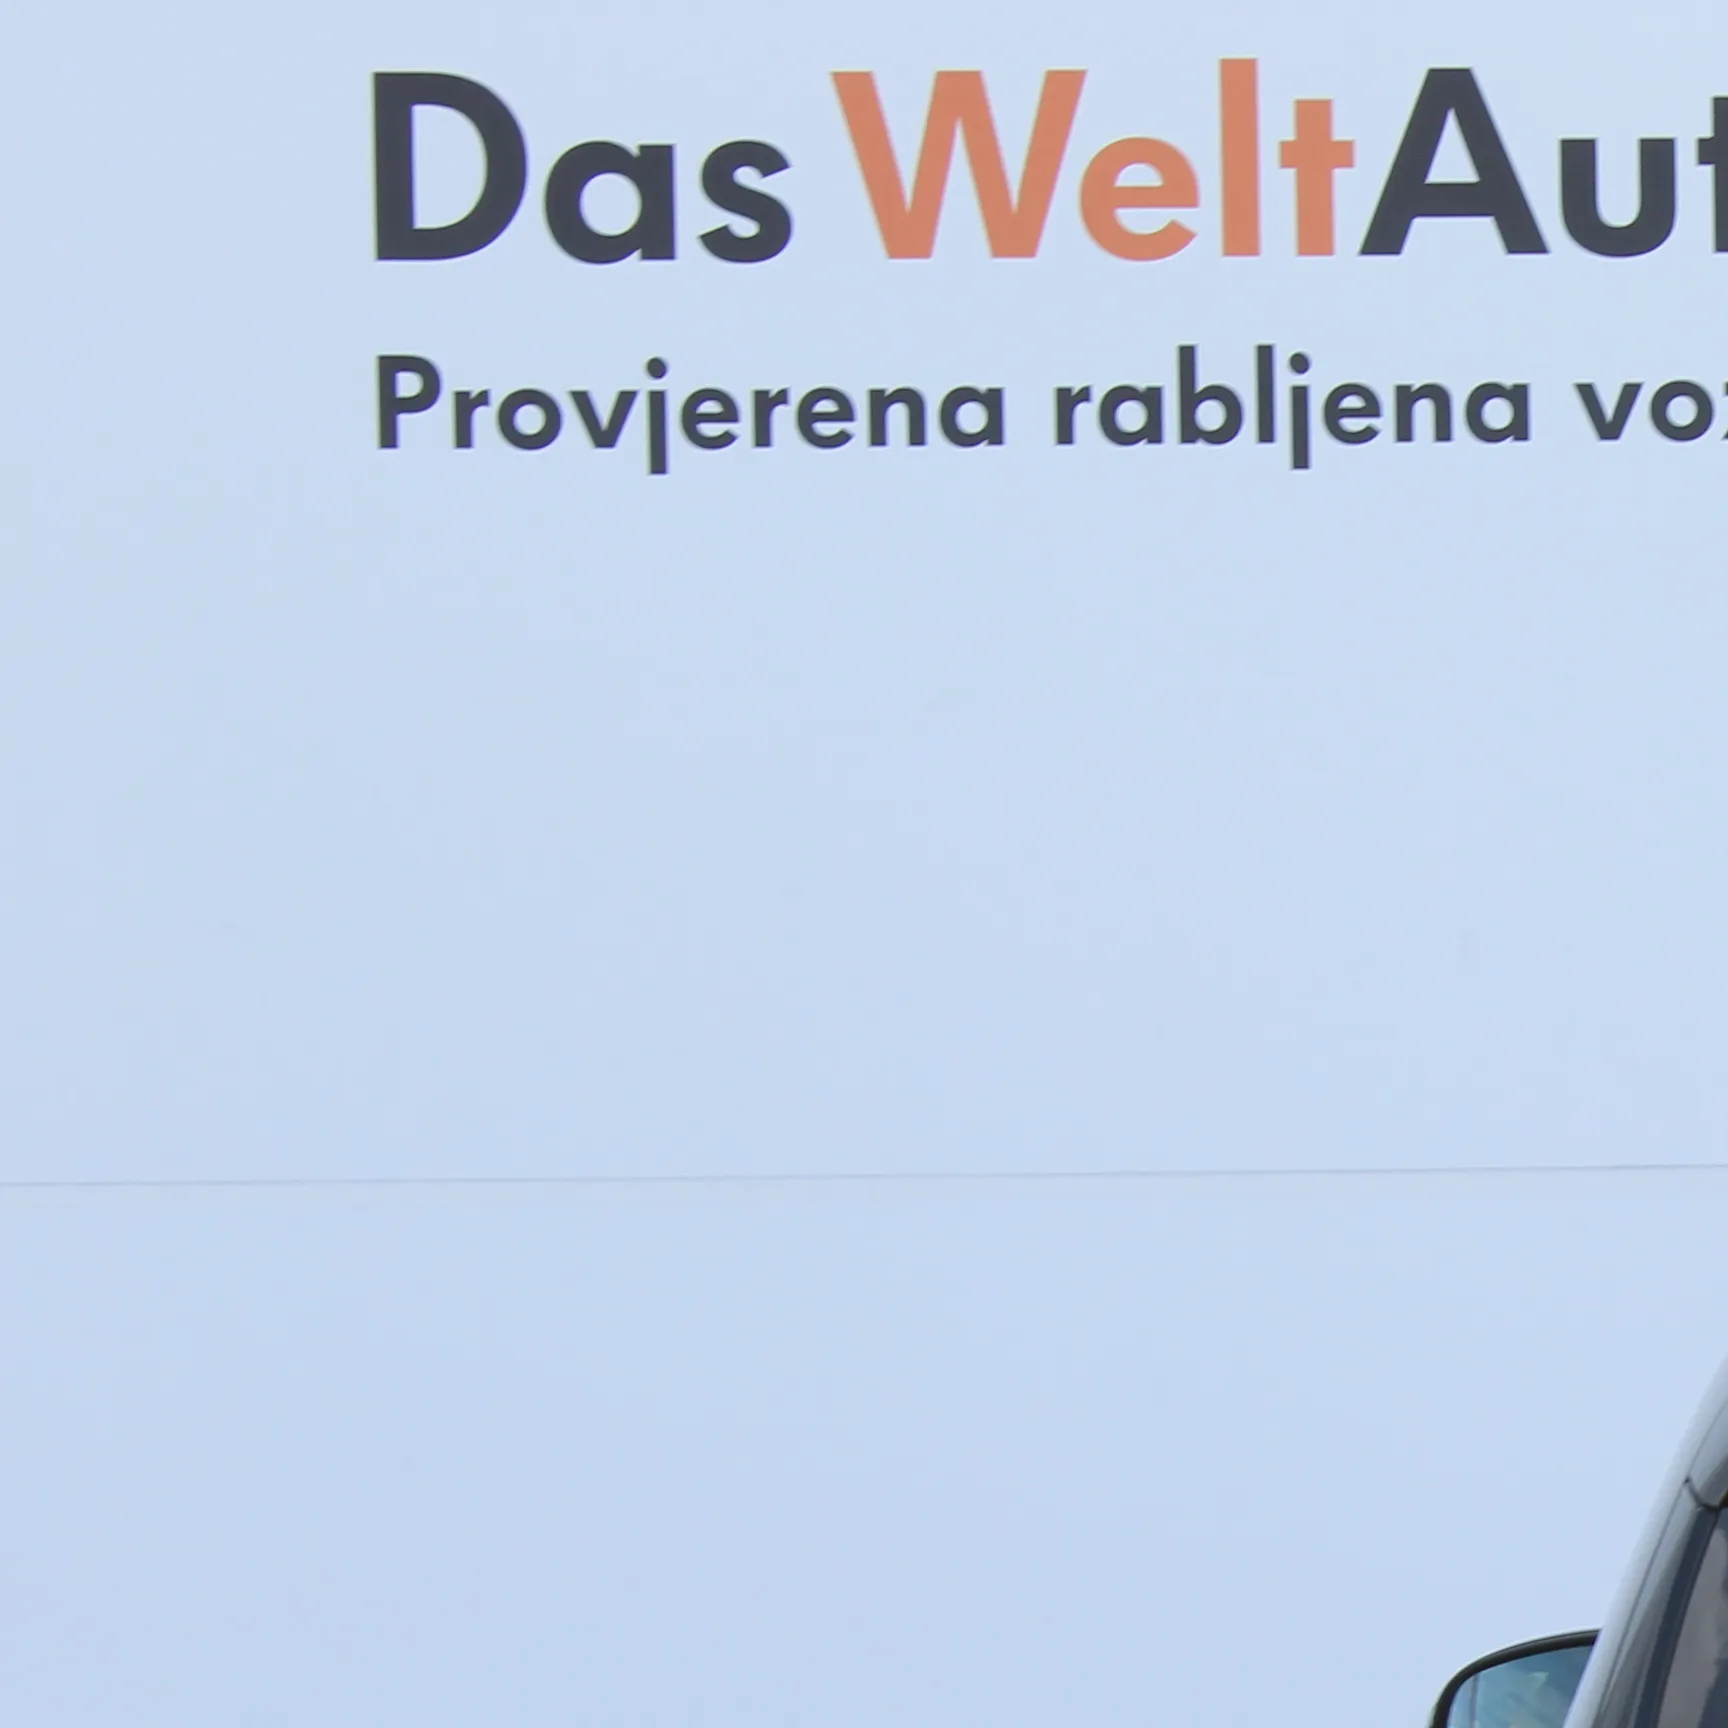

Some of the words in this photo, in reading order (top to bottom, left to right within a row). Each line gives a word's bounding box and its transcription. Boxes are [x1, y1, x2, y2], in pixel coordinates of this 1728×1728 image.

[374, 72, 791, 264] Das
[378, 355, 1003, 474] Provjerena
[1056, 345, 1529, 469] rabljena
